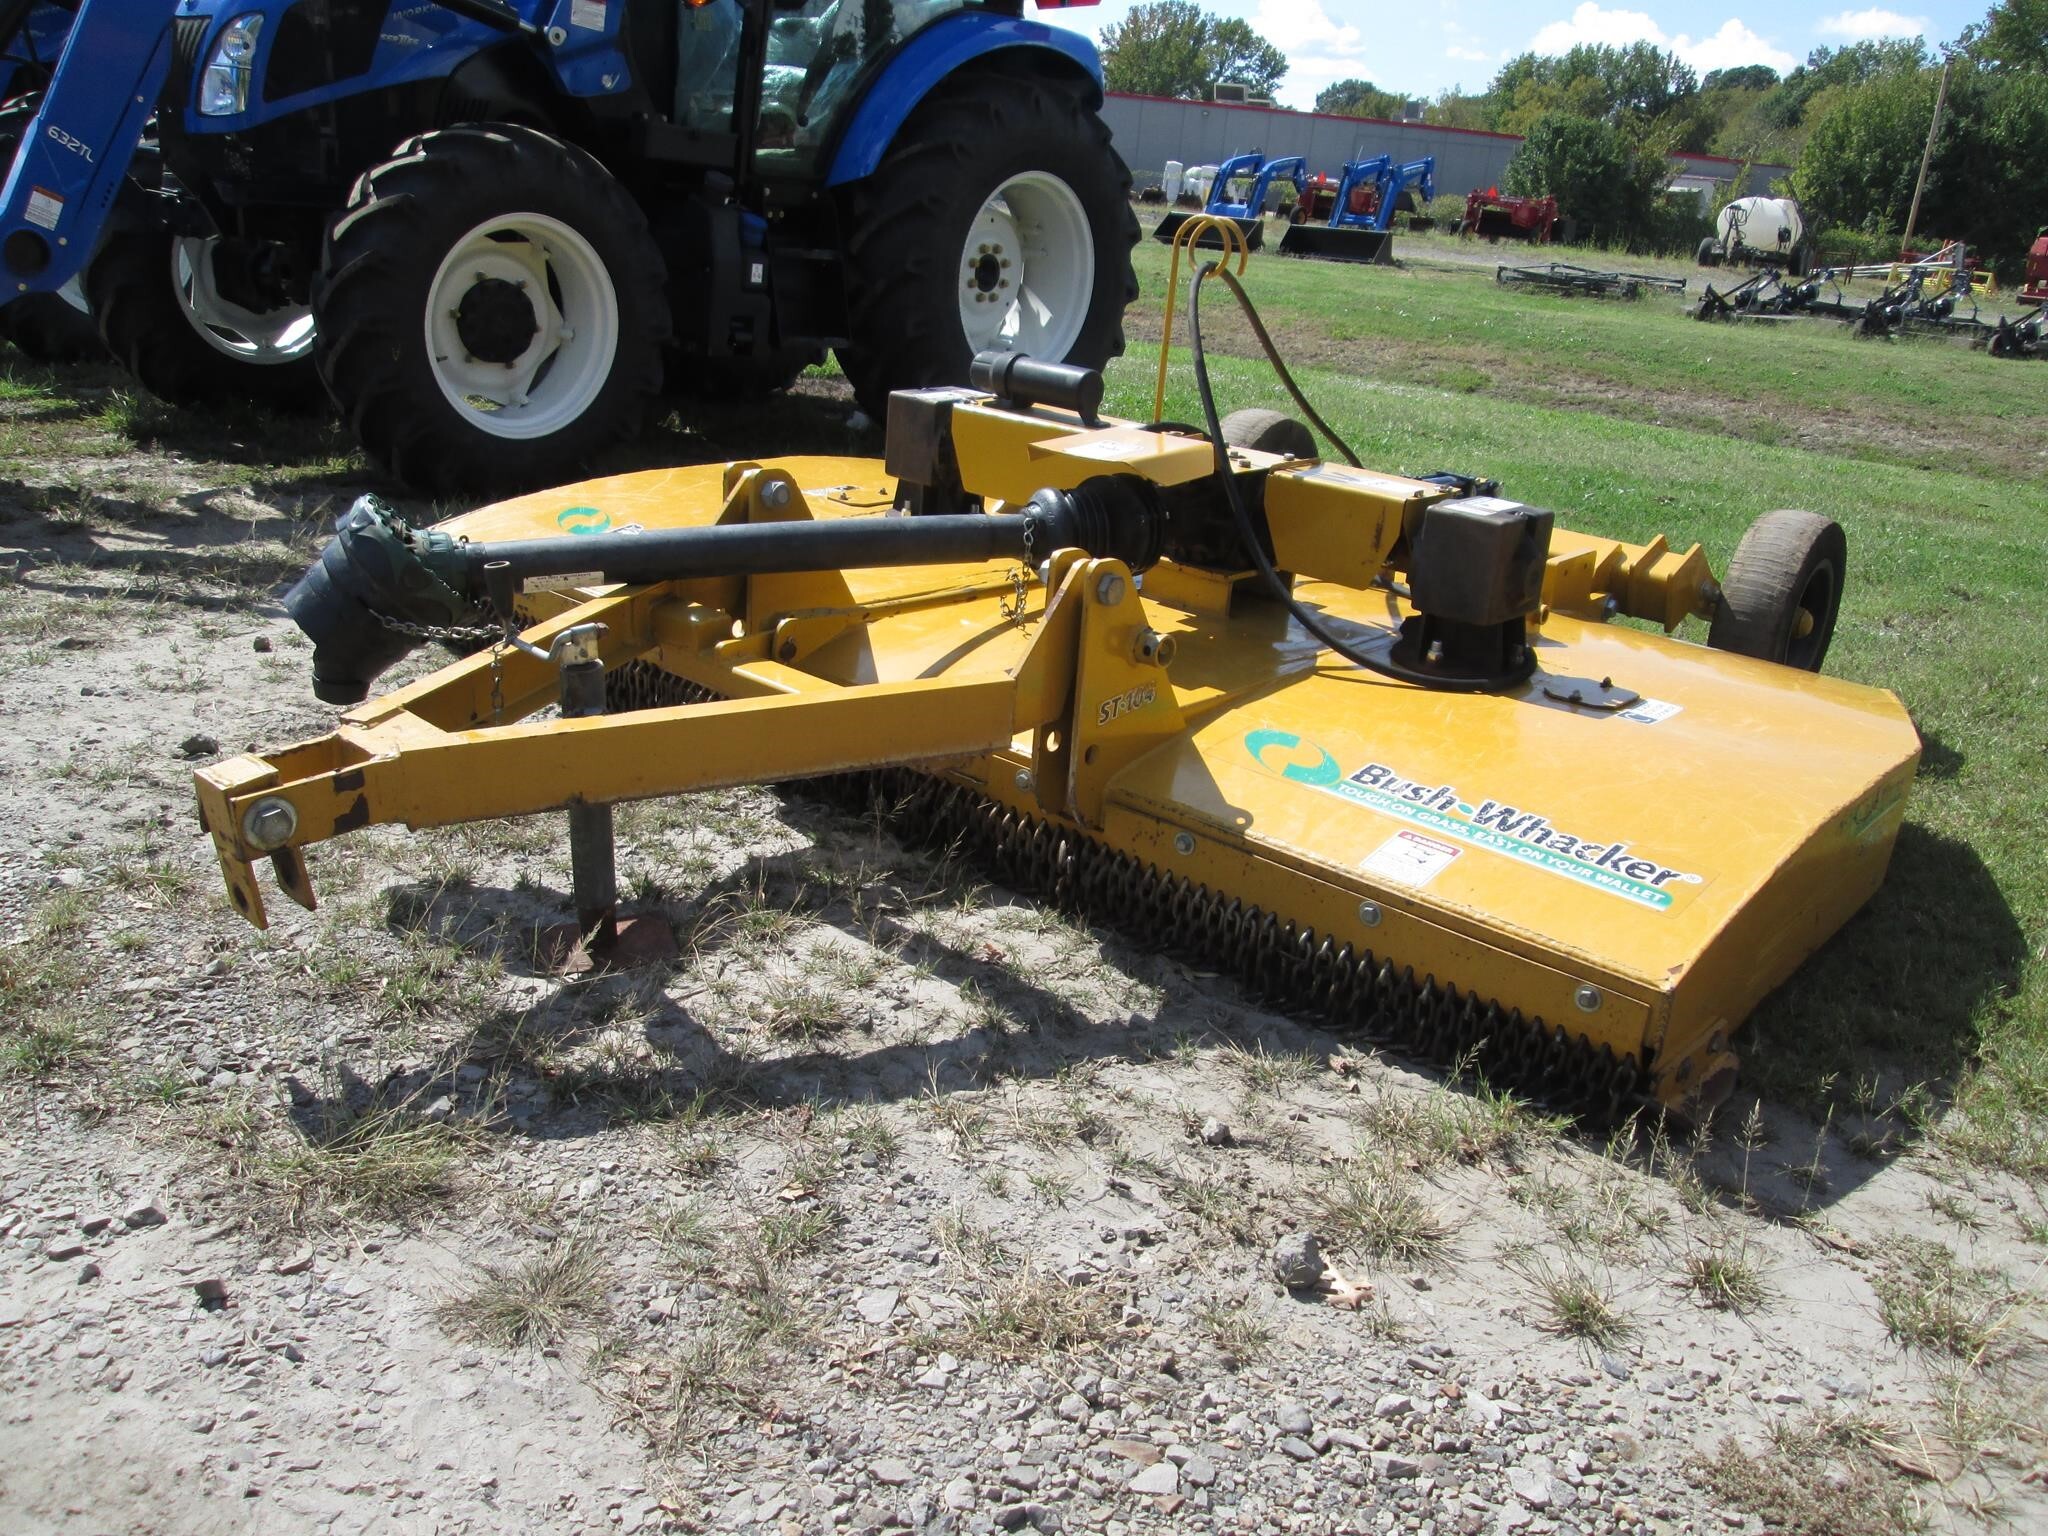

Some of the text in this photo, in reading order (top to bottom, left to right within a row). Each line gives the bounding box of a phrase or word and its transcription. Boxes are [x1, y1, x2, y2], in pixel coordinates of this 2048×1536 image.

[48, 125, 94, 163] 632TL
[1338, 783, 1665, 902] TOUGH ON GRASS, EASY ON YOUR WALLET
